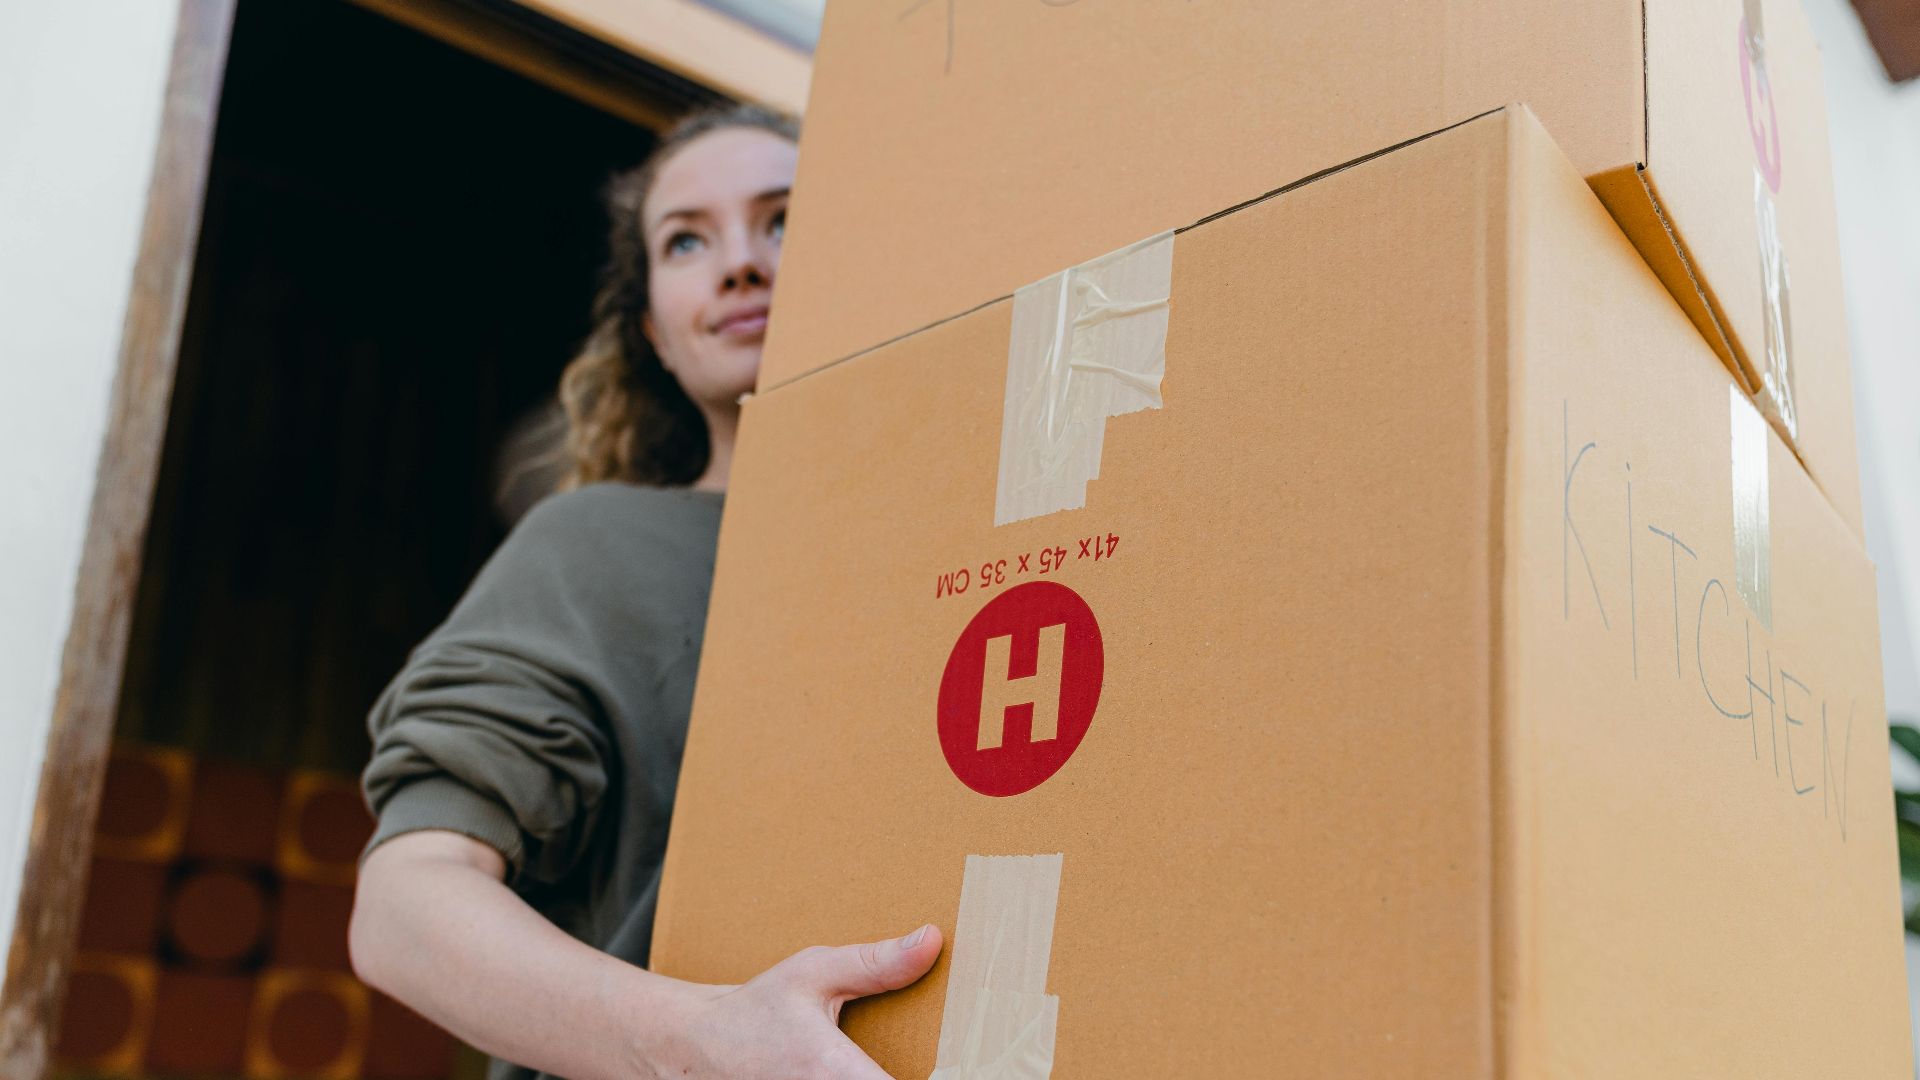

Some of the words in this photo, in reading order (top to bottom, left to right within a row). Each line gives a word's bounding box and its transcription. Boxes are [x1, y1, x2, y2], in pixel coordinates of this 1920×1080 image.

[980, 559, 1007, 588] 35
[1017, 553, 1031, 574] x
[1039, 546, 1067, 574] 45
[936, 568, 970, 599] CM
[976, 622, 1066, 751] H
